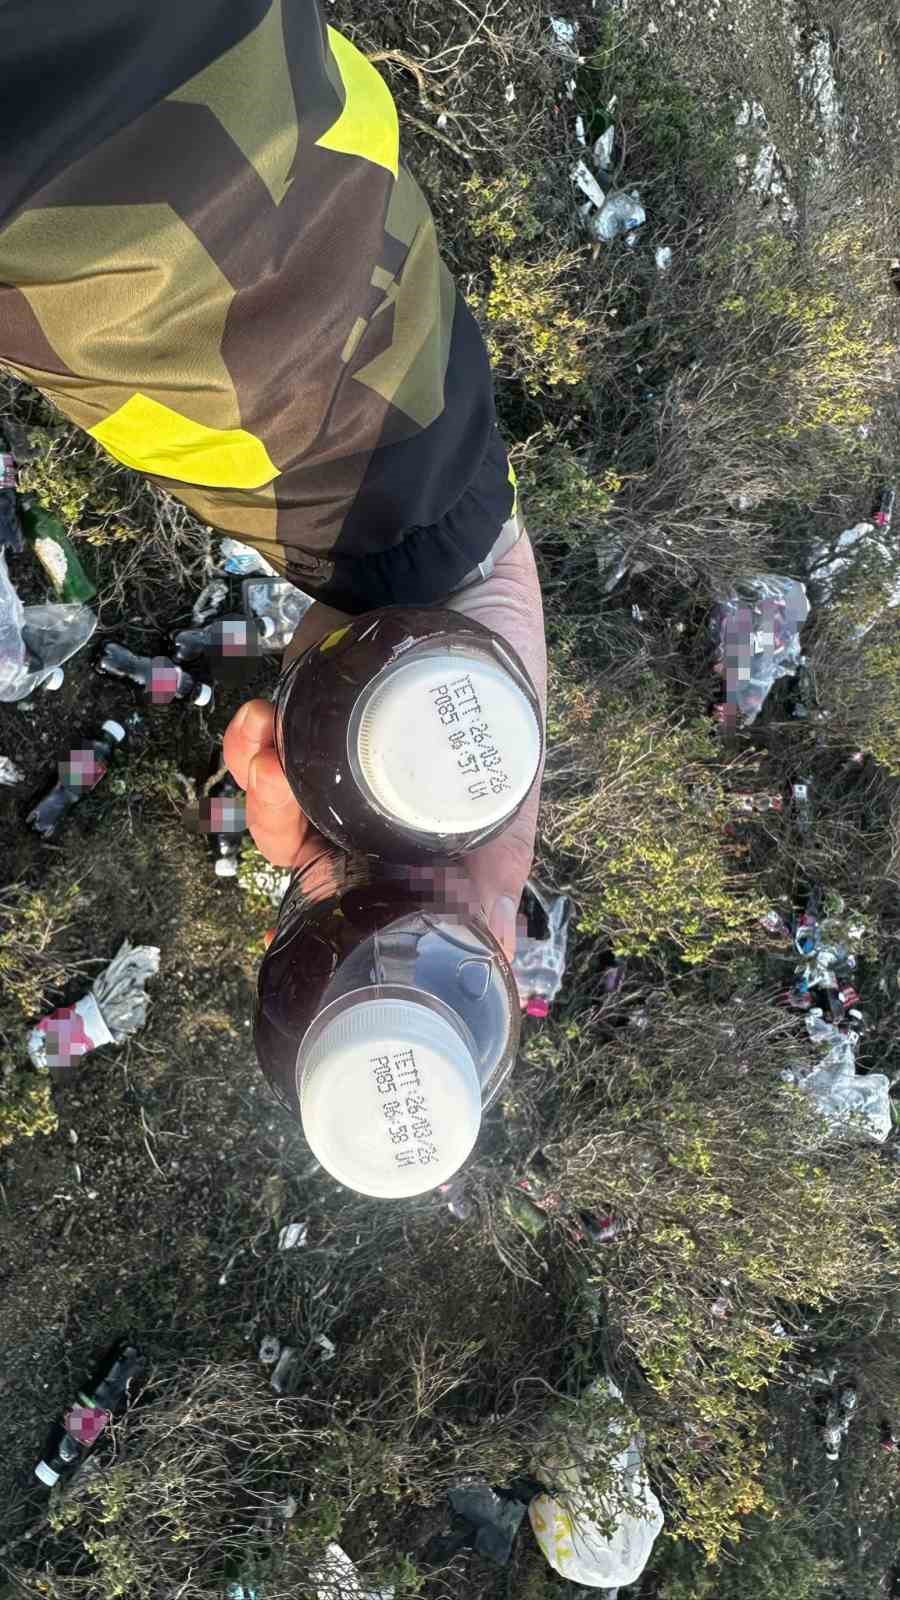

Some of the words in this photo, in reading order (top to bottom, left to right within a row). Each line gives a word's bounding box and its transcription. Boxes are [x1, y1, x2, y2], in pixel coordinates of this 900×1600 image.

[429, 685, 460, 726] P085
[448, 731, 480, 775] 06:57
[369, 1055, 397, 1095] P085
